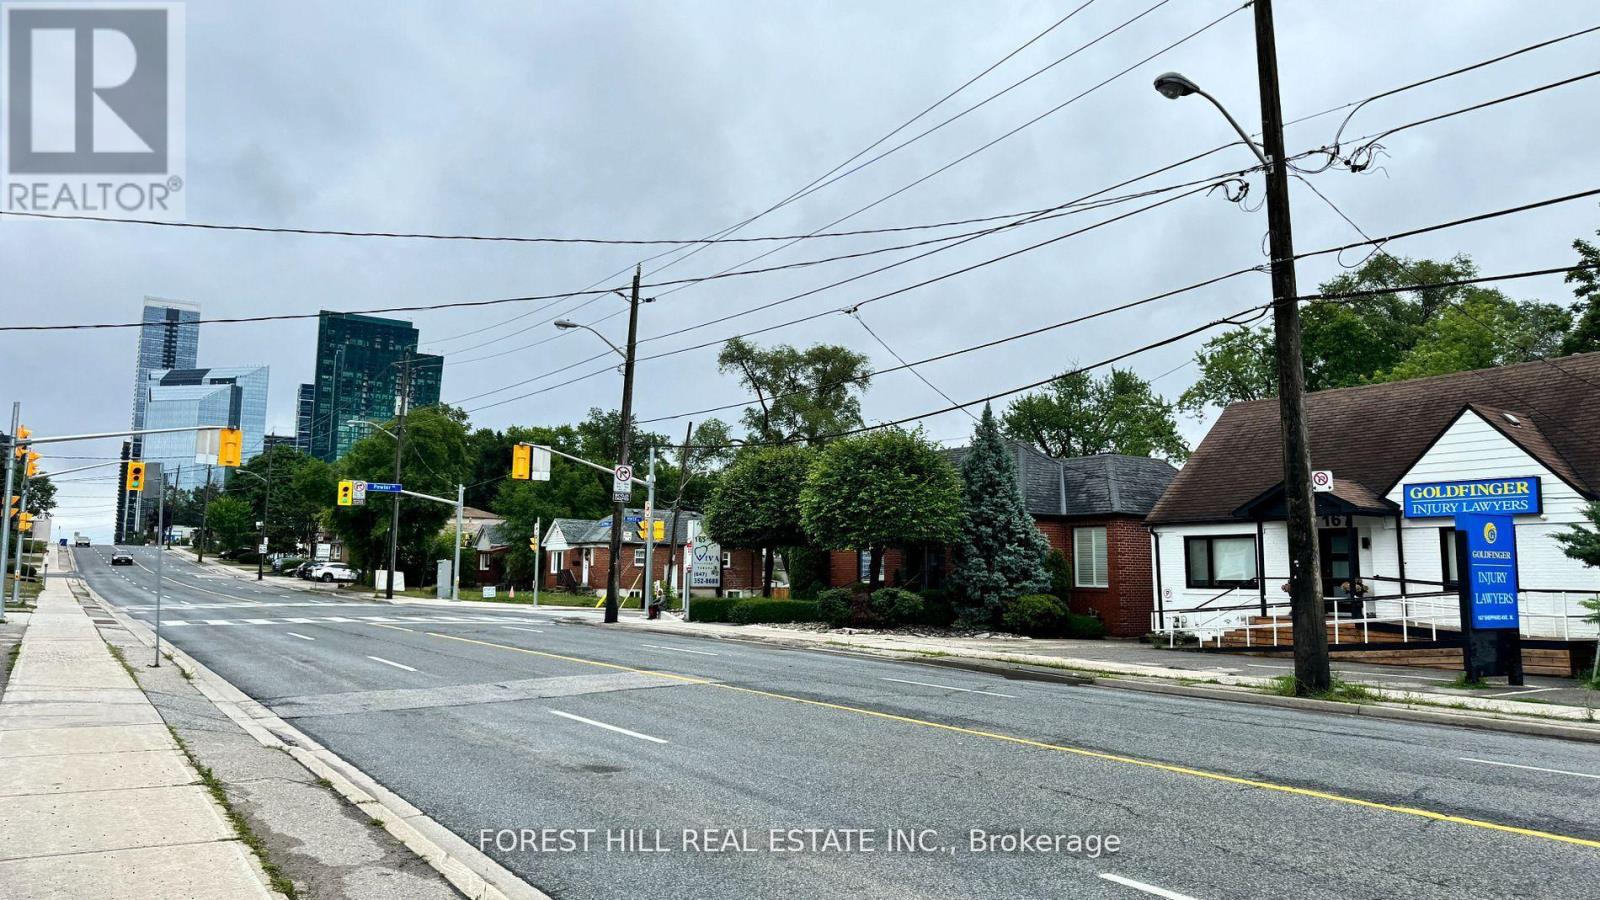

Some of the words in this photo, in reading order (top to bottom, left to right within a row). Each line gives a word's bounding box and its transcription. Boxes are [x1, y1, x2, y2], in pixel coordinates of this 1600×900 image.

[1409, 481, 1530, 499] GOLDFINGER
[1413, 503, 1459, 515] INJURY
[1462, 500, 1529, 513] LAWYERS
[1472, 550, 1511, 560] GOLDFINGER
[1478, 571, 1508, 585] INJURY
[1475, 592, 1514, 605] LAWYERS
